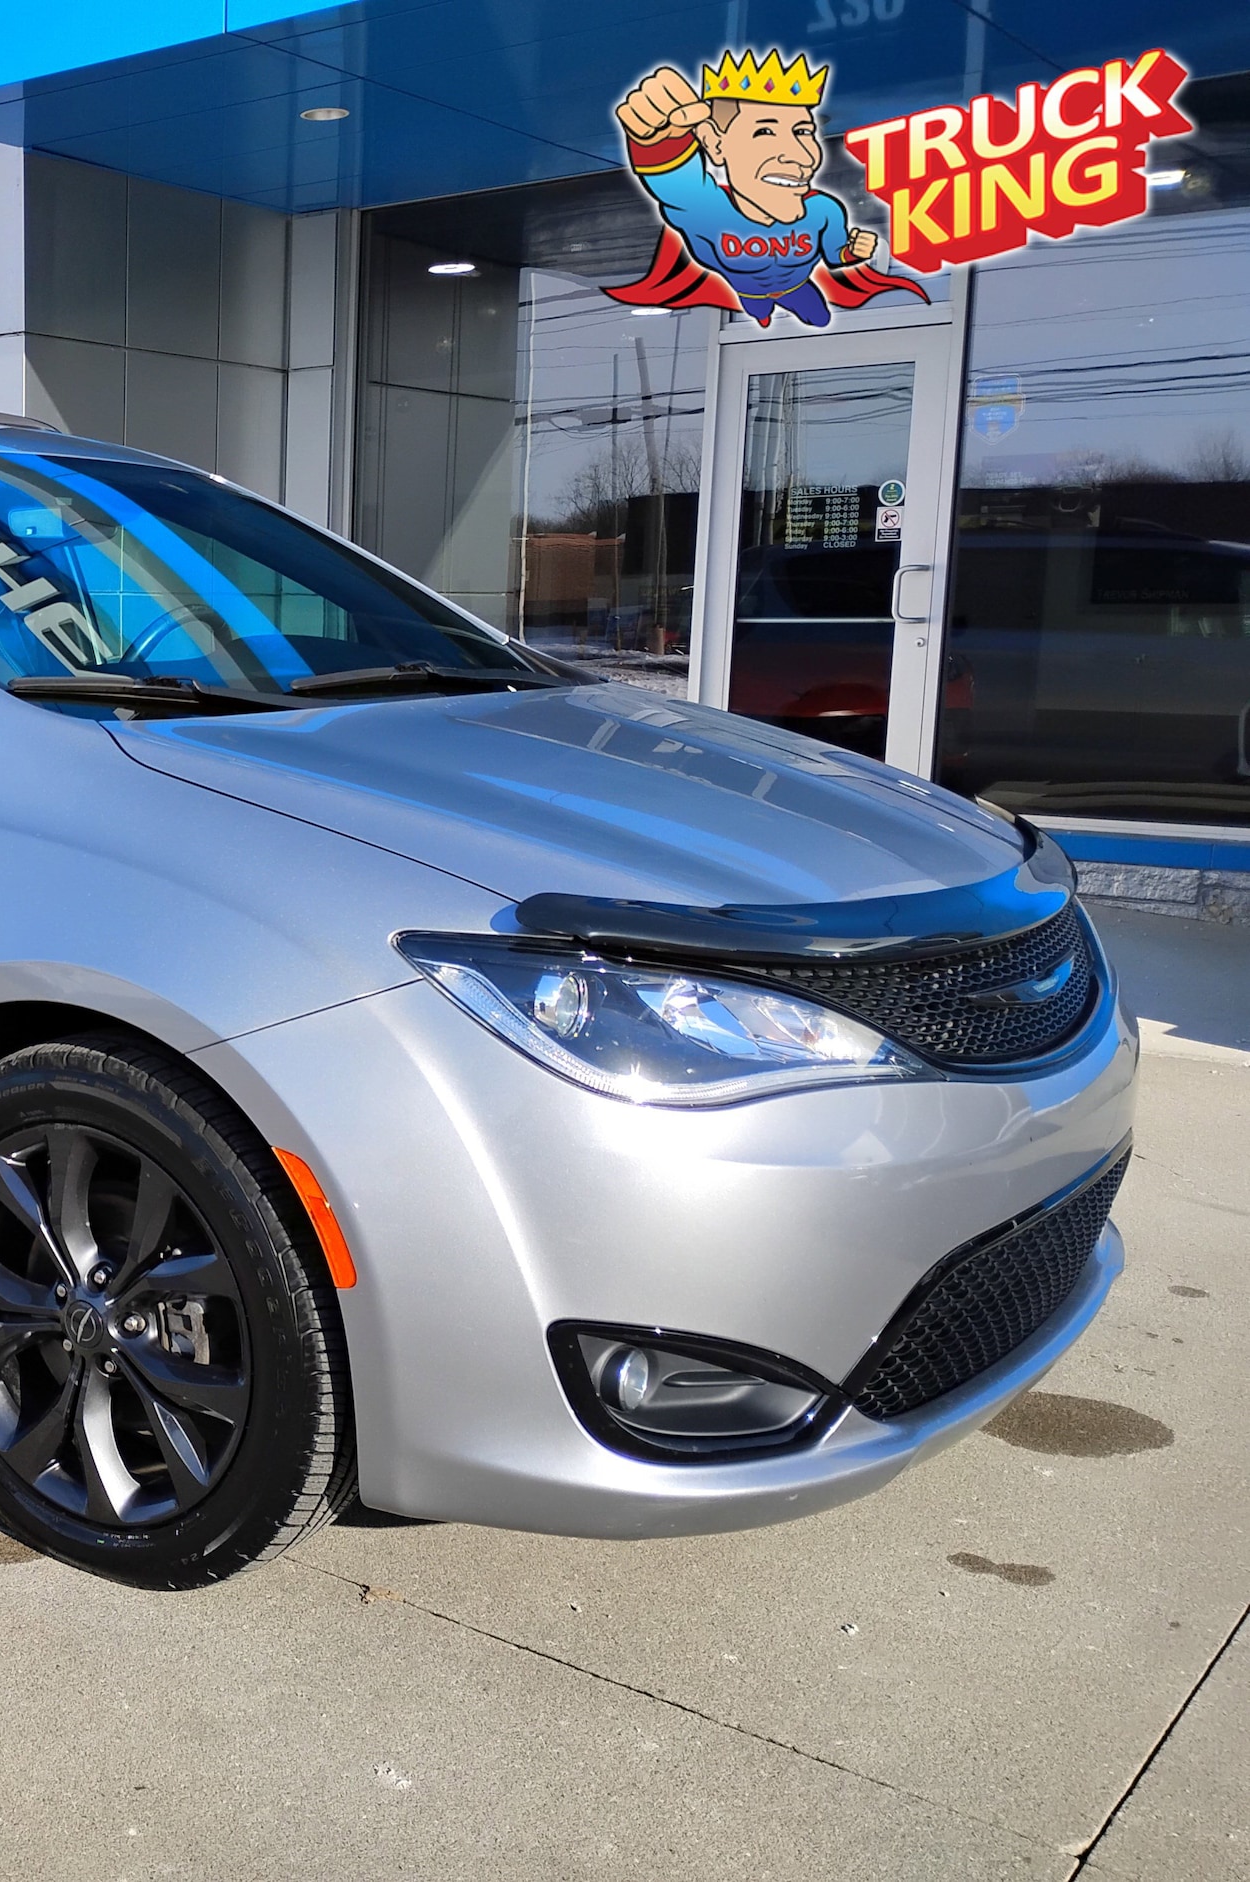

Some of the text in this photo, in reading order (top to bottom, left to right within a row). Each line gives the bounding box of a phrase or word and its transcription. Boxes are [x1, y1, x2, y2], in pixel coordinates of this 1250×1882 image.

[791, 485, 858, 496] SALES HOURS
[825, 496, 860, 505] 9:00-7:00
[823, 541, 856, 549] CLOSED
